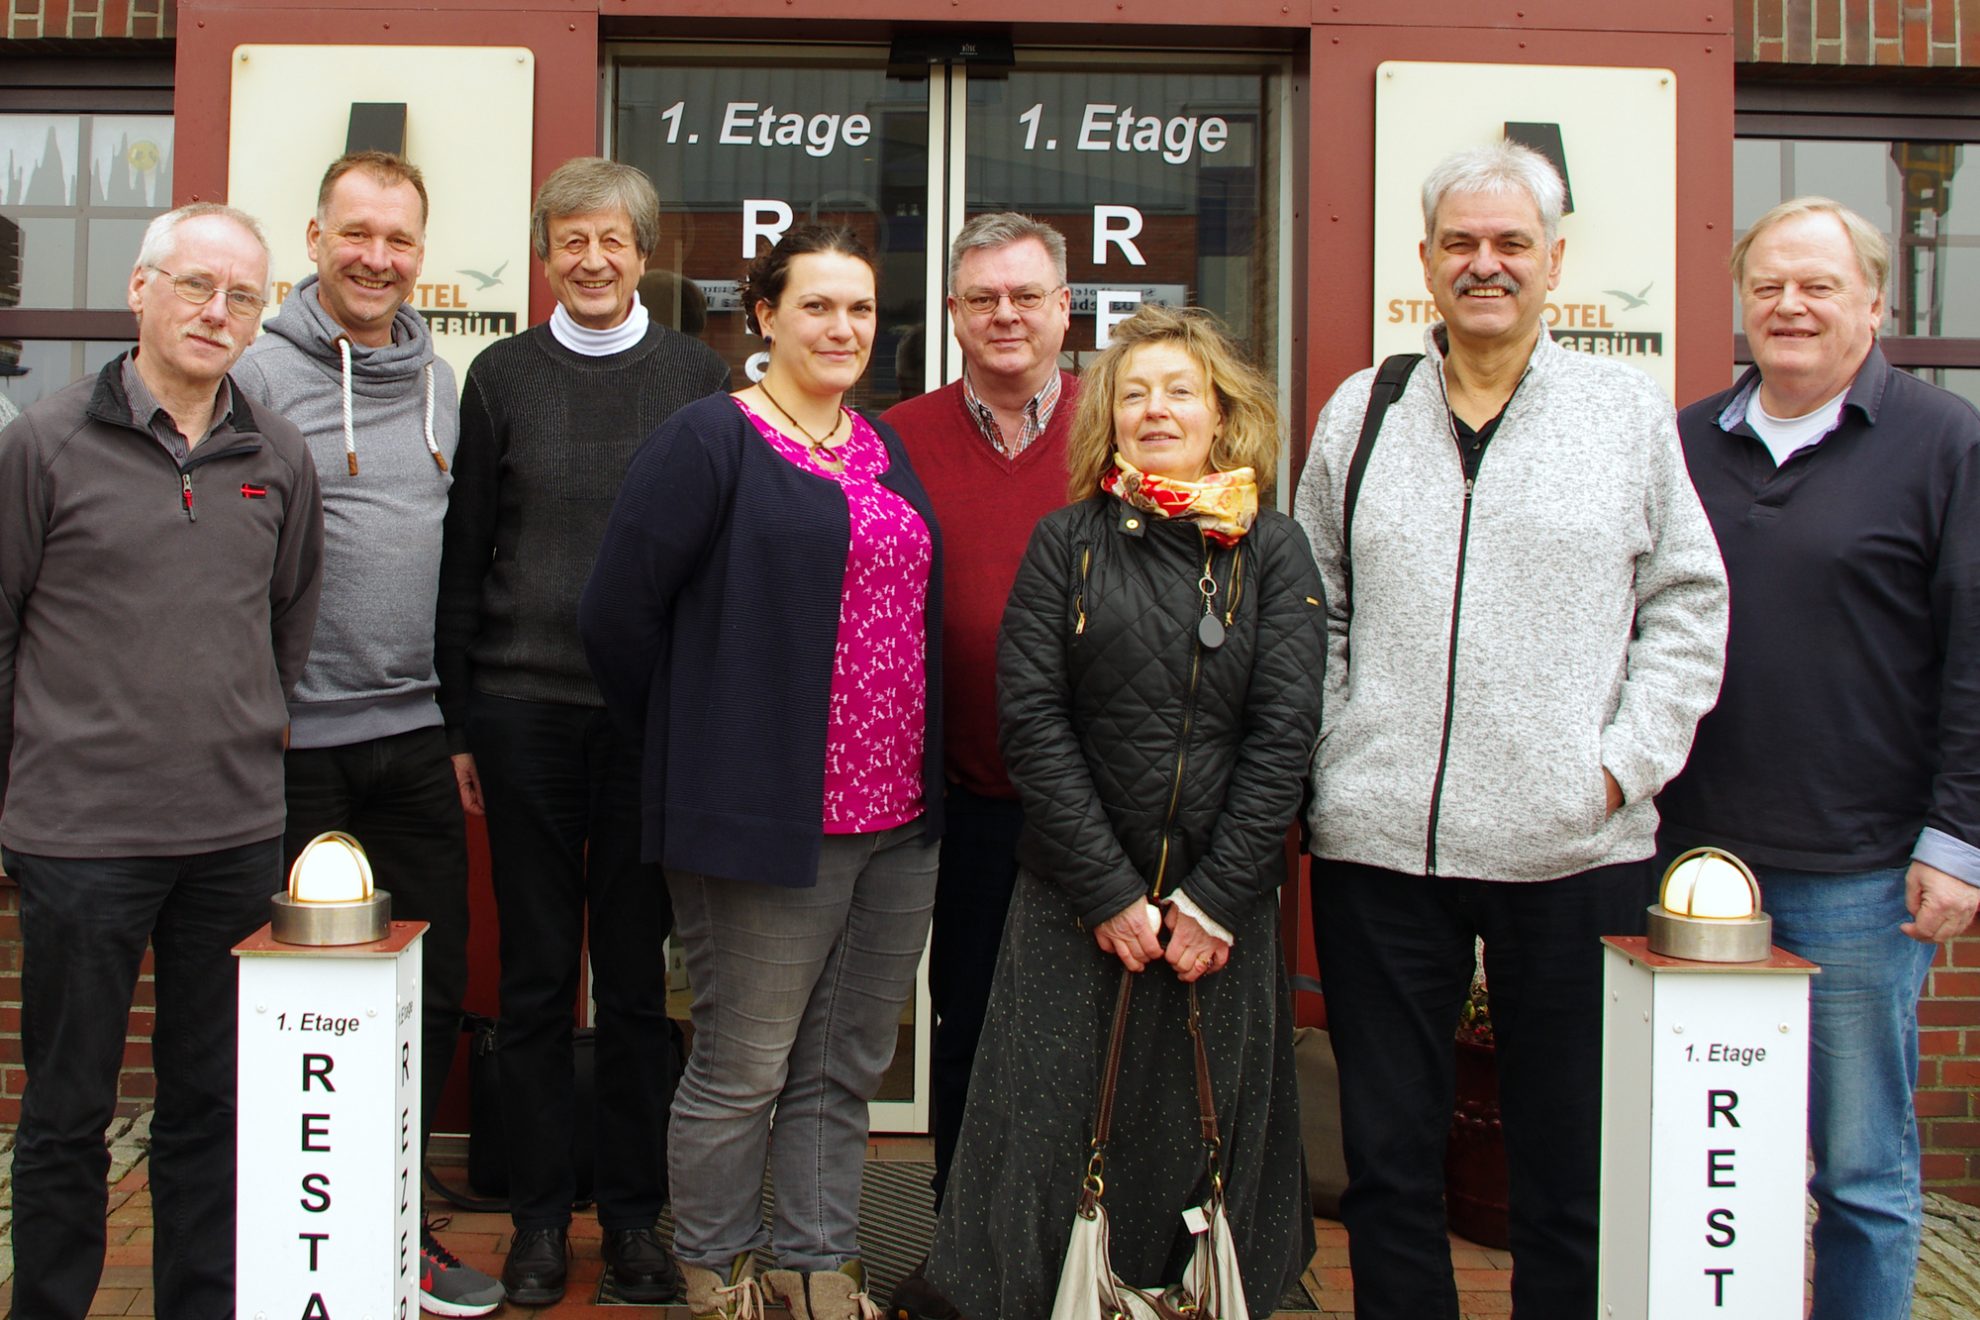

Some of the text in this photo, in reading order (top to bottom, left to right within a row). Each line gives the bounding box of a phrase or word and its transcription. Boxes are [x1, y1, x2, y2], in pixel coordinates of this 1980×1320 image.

[661, 101, 871, 157] 1. Etage
[1019, 103, 1228, 164] 1. Etage
[424, 312, 513, 336] EBÜLL
[277, 1012, 360, 1037] 1. Etage
[1685, 1043, 1766, 1067] 1. Etage
[1704, 1088, 1742, 1307] REST
